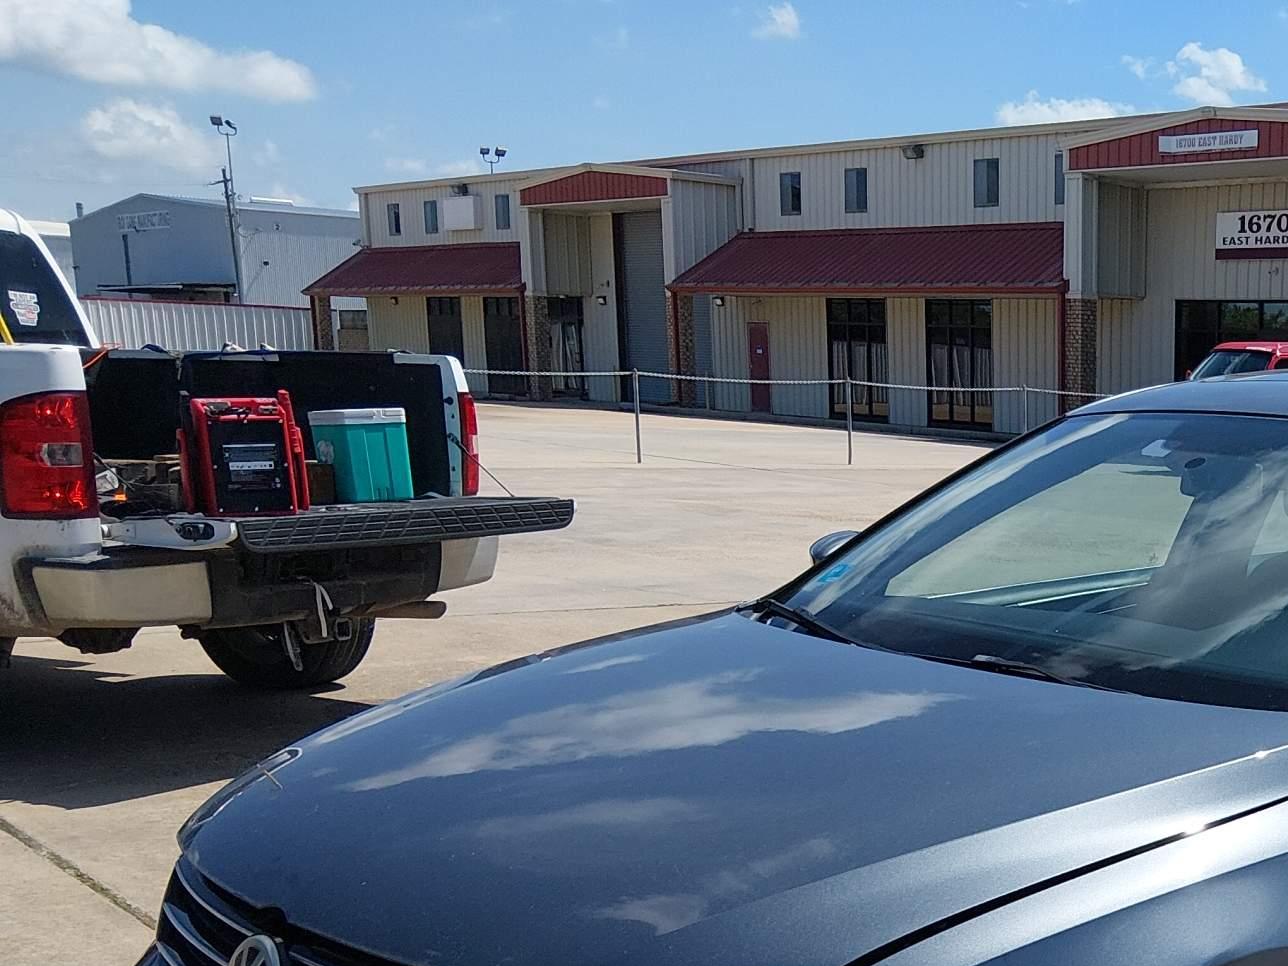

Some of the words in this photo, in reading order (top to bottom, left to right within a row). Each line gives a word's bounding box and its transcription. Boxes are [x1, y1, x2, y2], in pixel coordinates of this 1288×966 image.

[1175, 137, 1196, 149] 16700
[1198, 135, 1217, 147] EAST
[1219, 134, 1244, 145] HARDY
[1222, 236, 1250, 245] EAST
